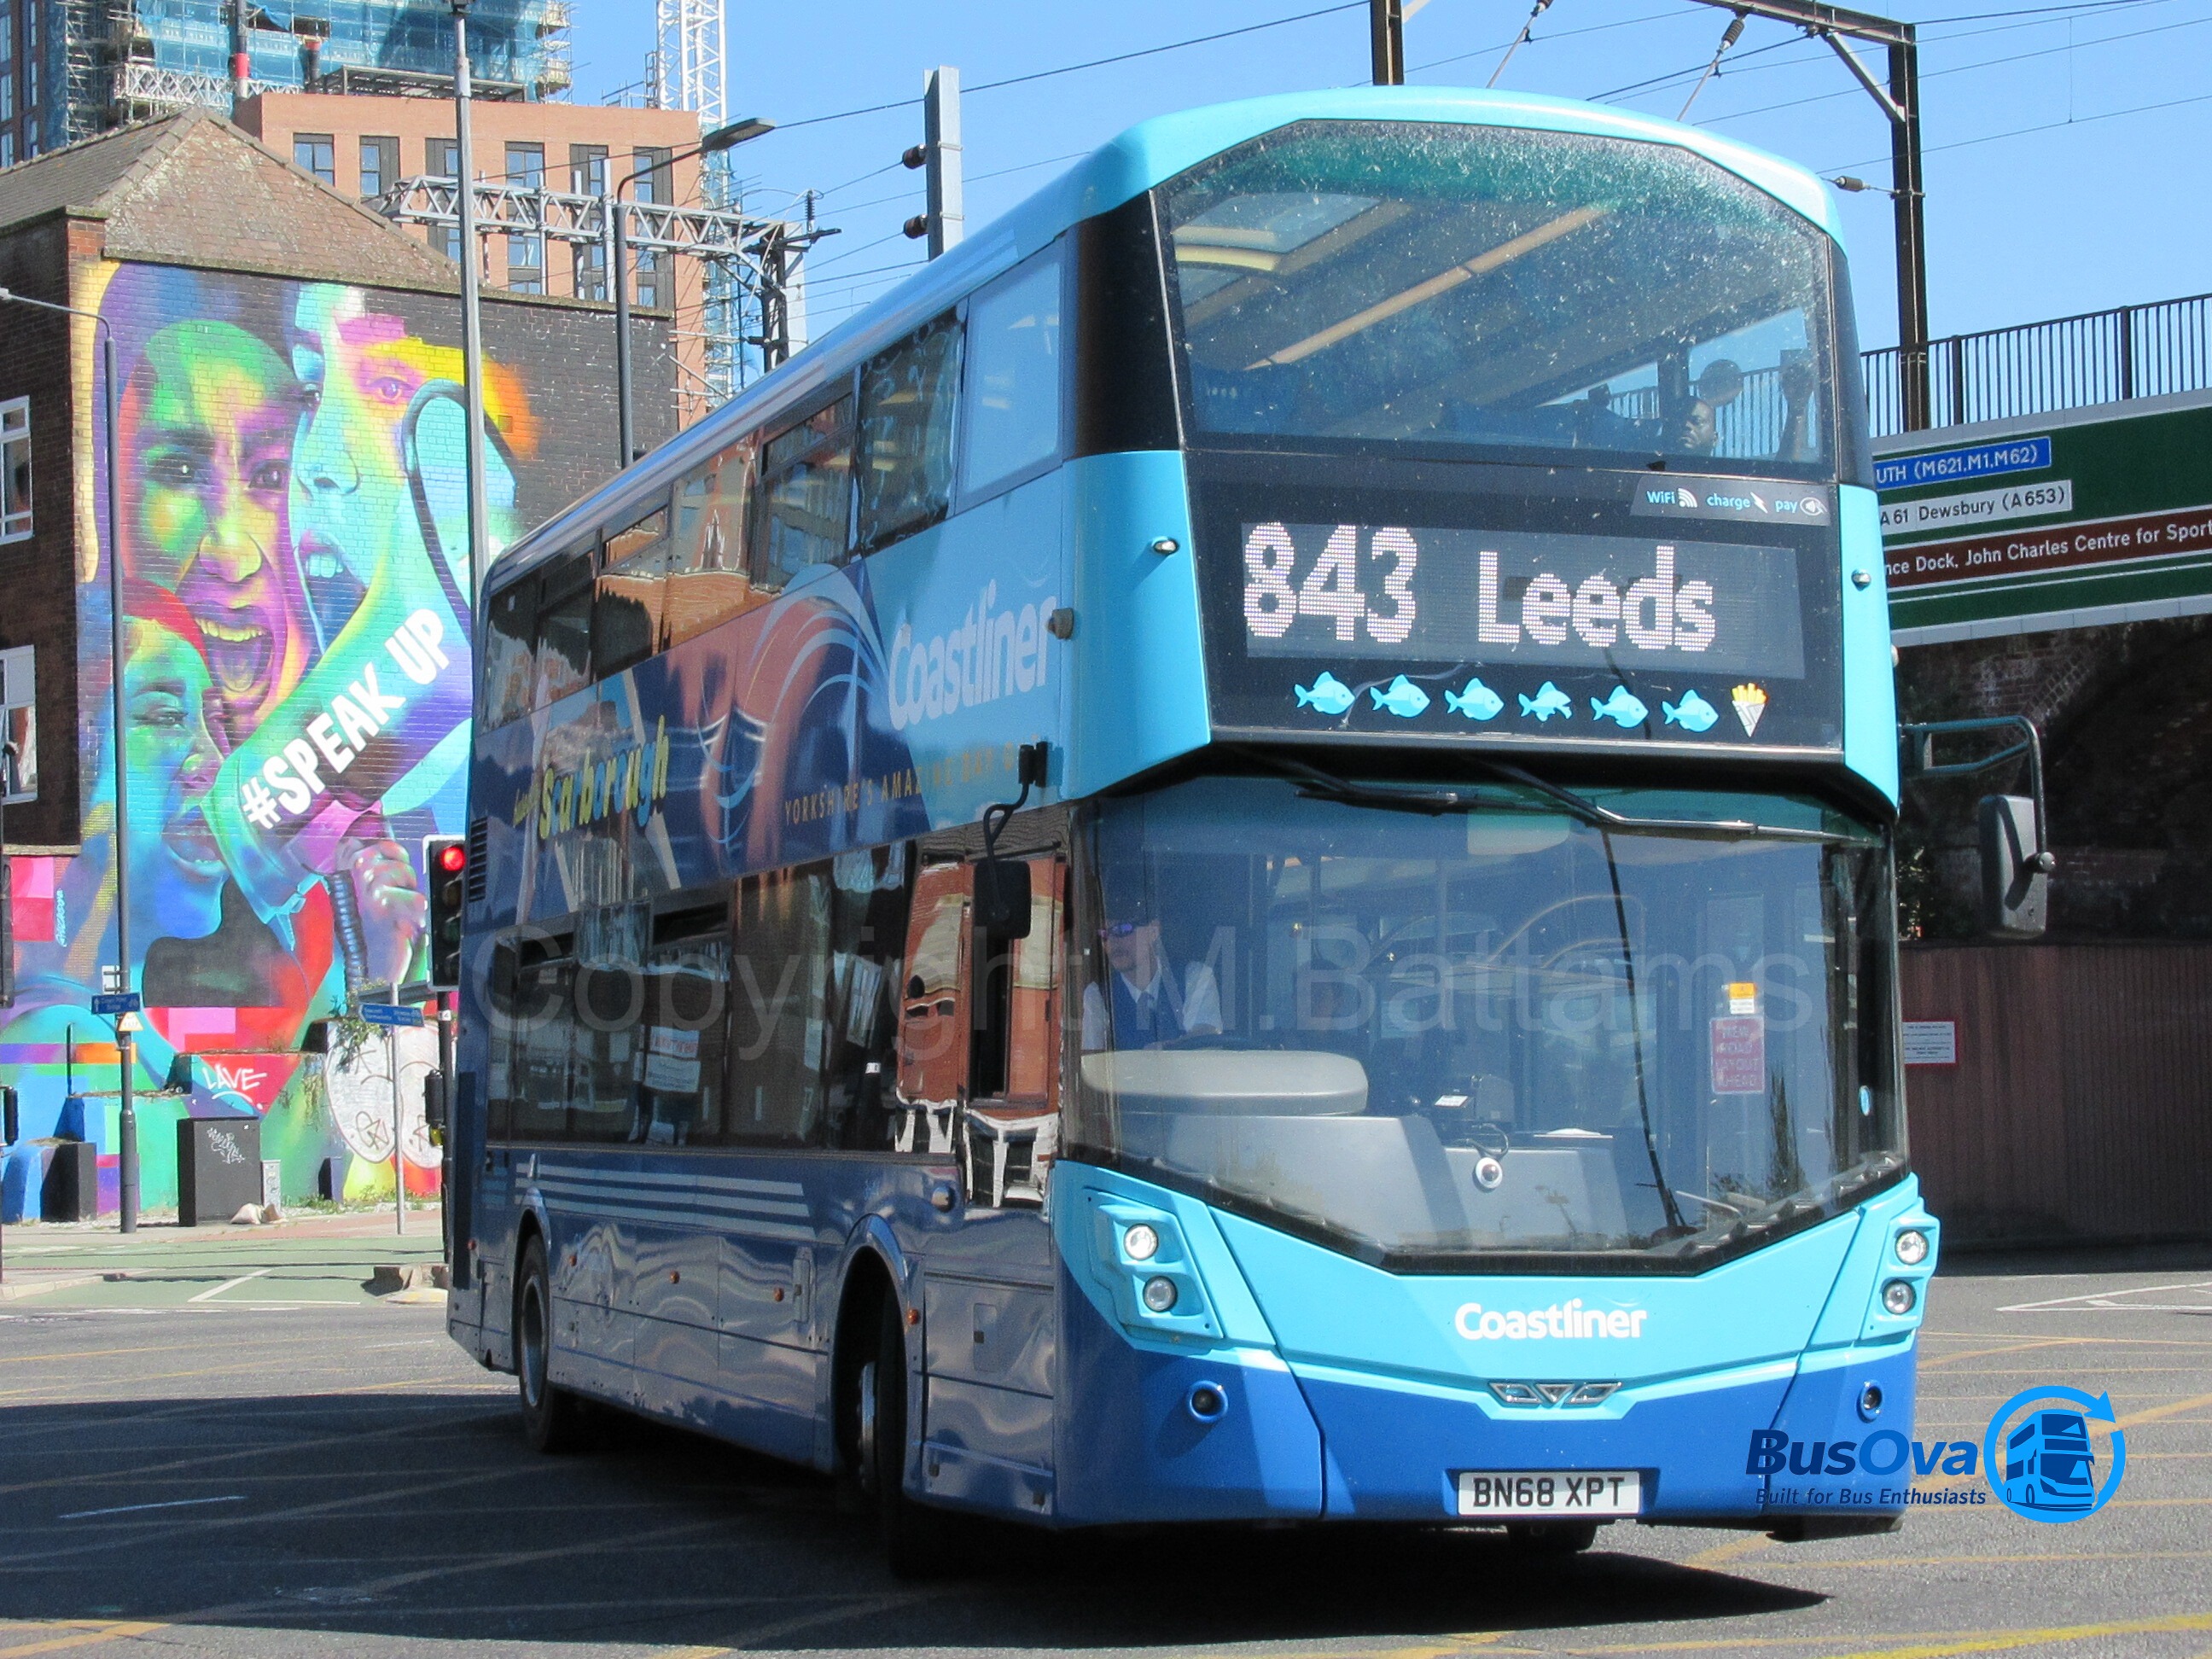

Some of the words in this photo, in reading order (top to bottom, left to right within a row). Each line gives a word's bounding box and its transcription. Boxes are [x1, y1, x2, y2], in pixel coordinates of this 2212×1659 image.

[1876, 465, 1906, 484] UTH
[1646, 490, 1676, 504] WiFi
[1706, 492, 1750, 511] charge
[1775, 499, 1798, 513] pay
[1918, 496, 1995, 521] Dewsbury
[1885, 562, 1910, 576] nce
[1965, 548, 2002, 567] John
[2006, 538, 2069, 561] Charles
[2075, 532, 2131, 552] Centre
[2136, 527, 2161, 544] for
[1243, 521, 1417, 643] 843
[1478, 544, 1716, 652] Leeds
[888, 579, 1057, 731] Coastliner
[241, 661, 407, 830] #SPEAK
[384, 608, 450, 685] UP
[538, 714, 670, 840] Scarborough
[784, 777, 873, 826] YORKSHIRE'S
[1454, 1297, 1648, 1341] Coastliner
[1473, 1477, 1555, 1507] BN68
[1565, 1476, 1625, 1507] XPT
